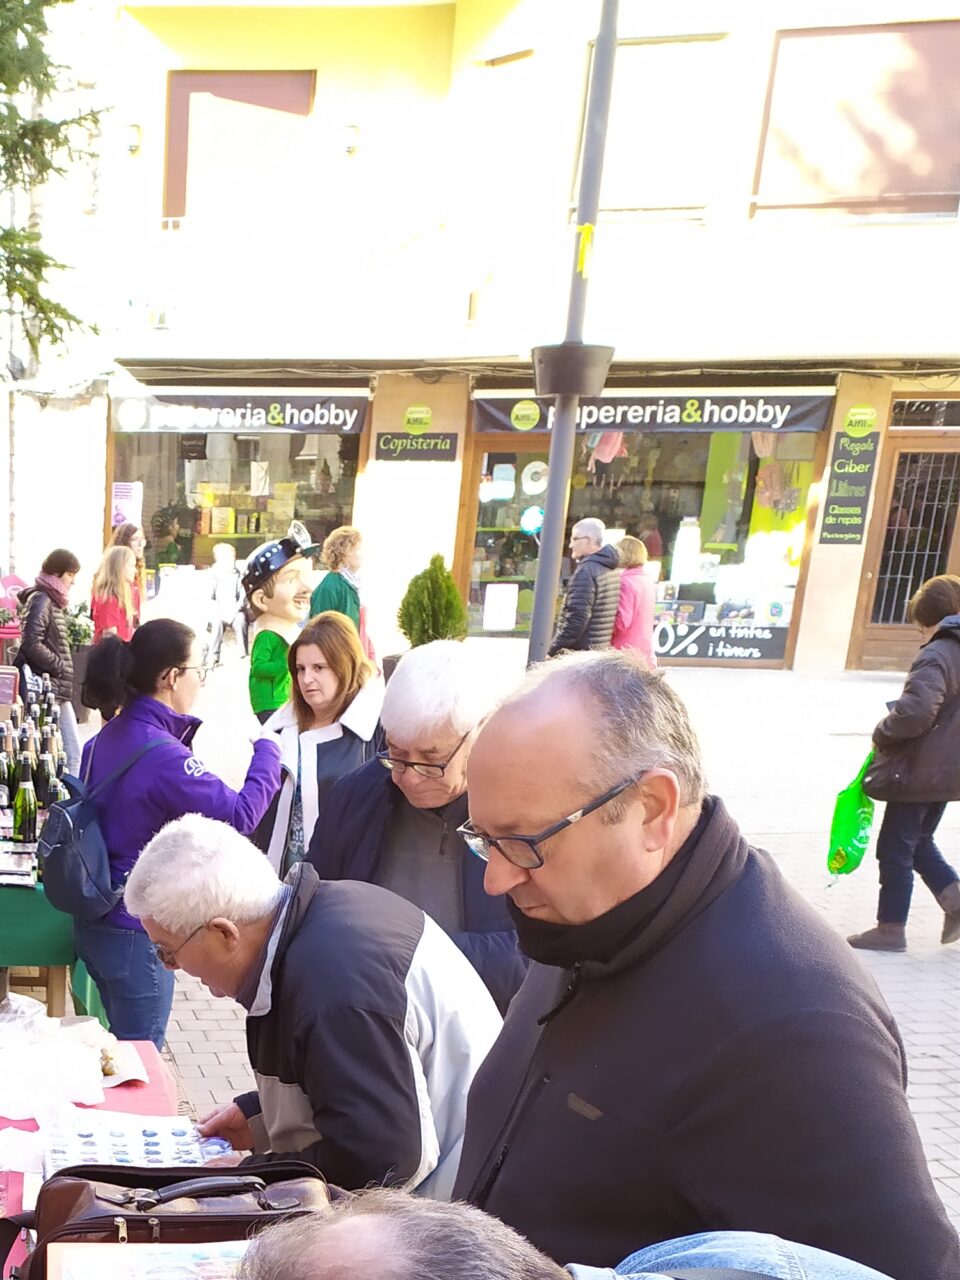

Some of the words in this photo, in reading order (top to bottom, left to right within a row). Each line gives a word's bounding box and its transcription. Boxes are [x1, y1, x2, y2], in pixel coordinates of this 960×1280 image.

[380, 434, 451, 456] Copisteria
[839, 437, 874, 455] Regals
[834, 459, 871, 473] Ciber
[825, 515, 837, 524] de
[709, 628, 725, 638] en
